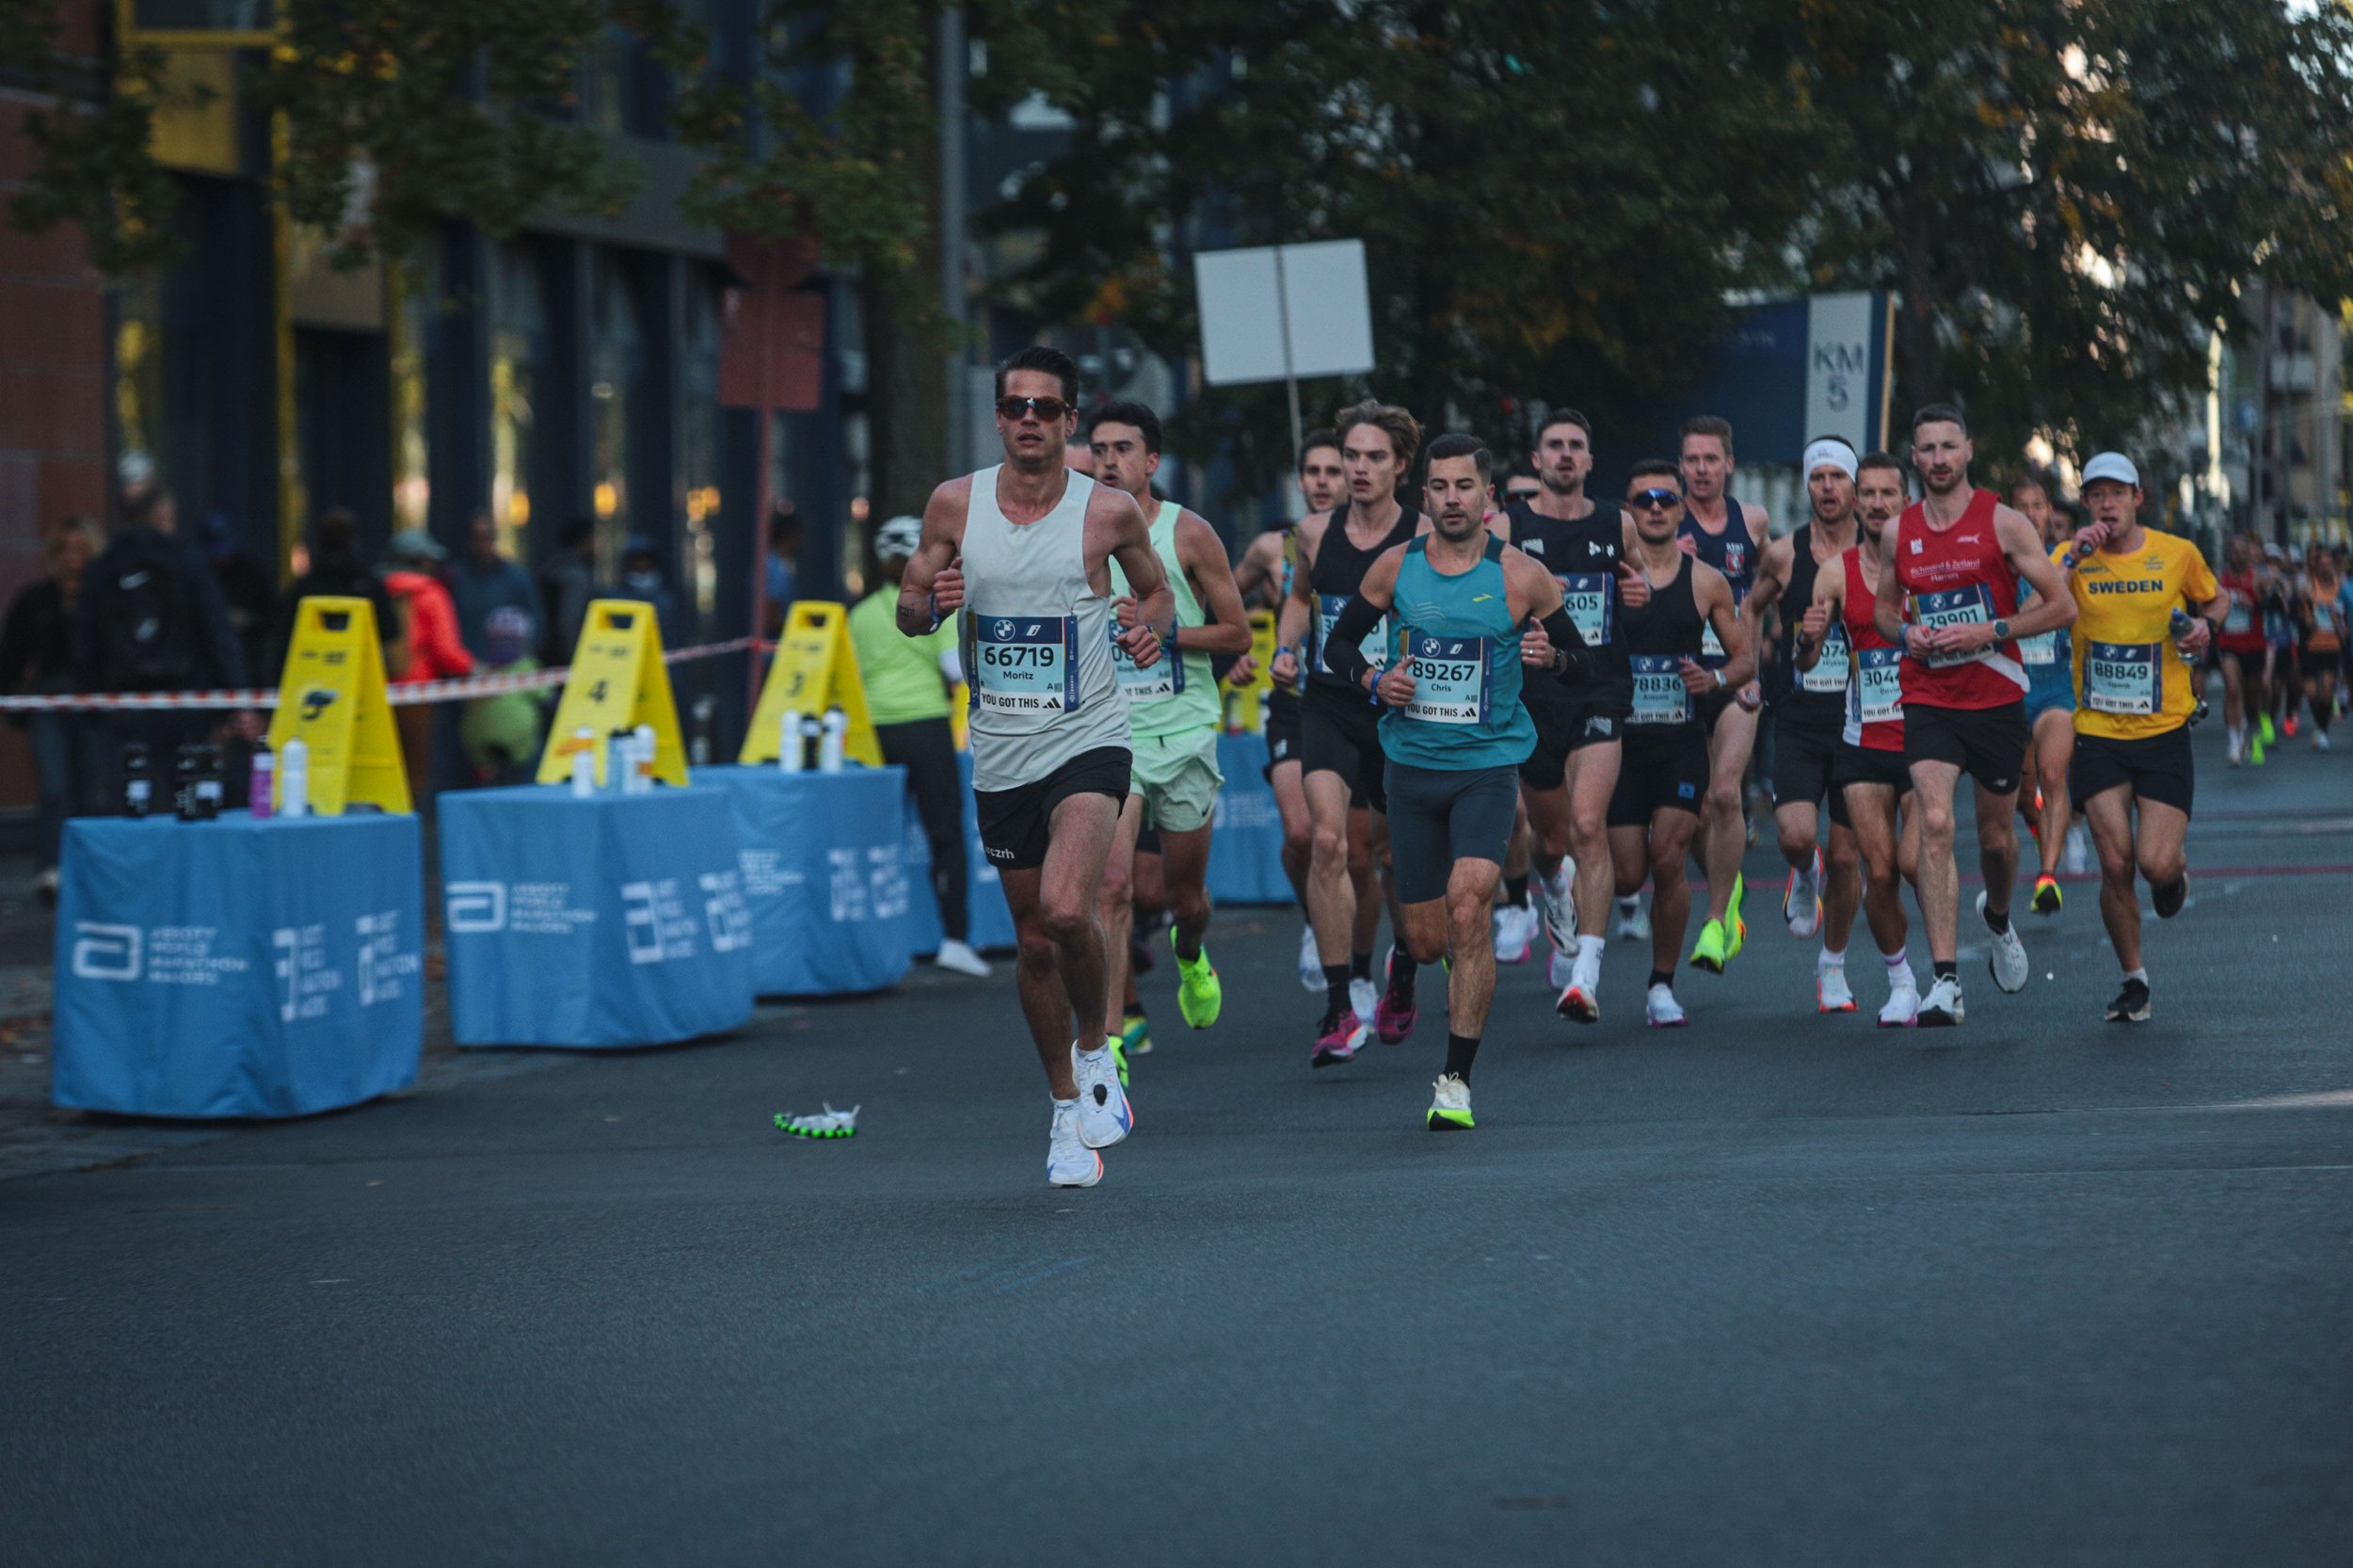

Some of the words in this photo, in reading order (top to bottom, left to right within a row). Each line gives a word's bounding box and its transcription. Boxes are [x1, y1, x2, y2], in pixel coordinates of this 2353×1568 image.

[1813, 343, 1864, 374] KM
[1827, 376, 1849, 412] 5
[2089, 580, 2163, 595] SWEDEN
[1564, 595, 1598, 612] 605
[984, 647, 1054, 667] 66719
[1002, 671, 1034, 680] Moritz
[1412, 661, 1475, 681] 89267
[2094, 662, 2148, 680] 88849
[587, 680, 607, 703] 4
[1431, 683, 1451, 692] Chris
[982, 693, 997, 705] YOU
[999, 698, 1016, 709] GOT
[1018, 698, 1039, 709] THIS
[1407, 704, 1420, 713] YOU
[1422, 706, 1437, 715] GOT
[1440, 708, 1458, 717] THIS
[511, 909, 597, 922] MARATHON
[149, 957, 250, 971] MARATHON
